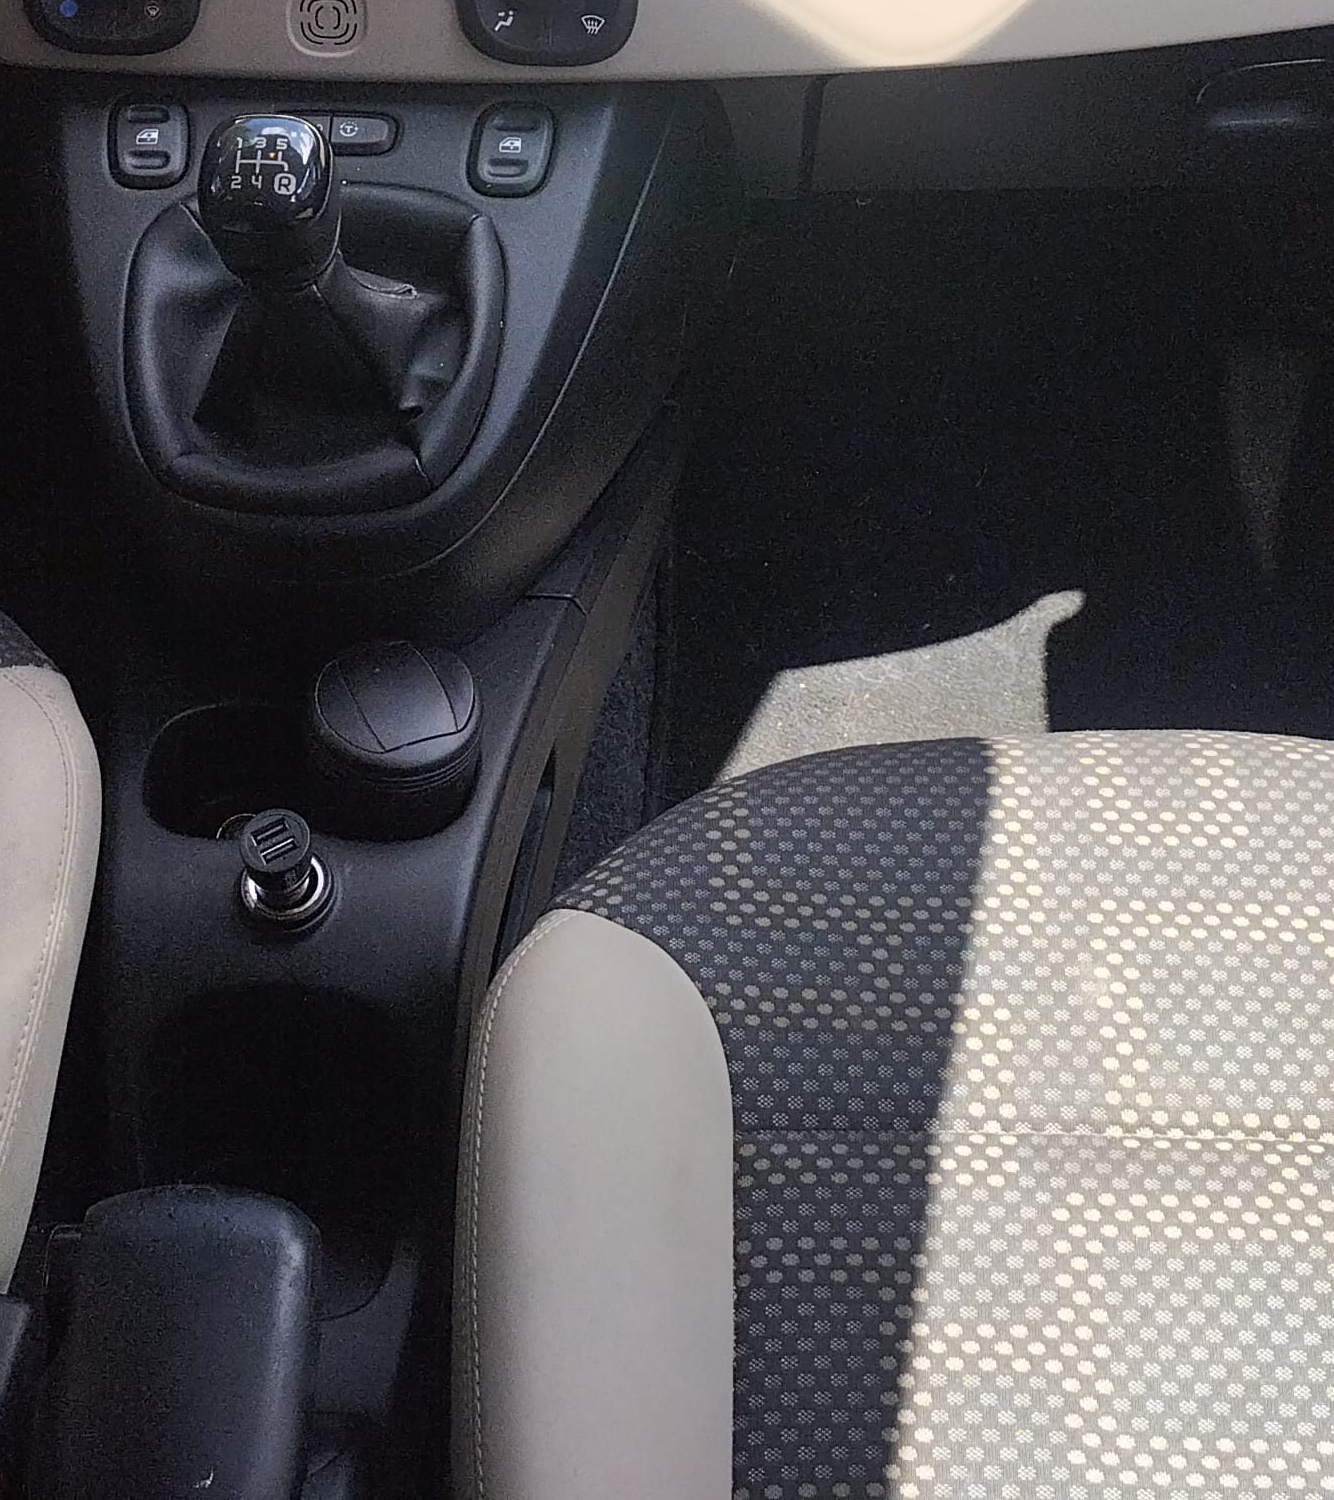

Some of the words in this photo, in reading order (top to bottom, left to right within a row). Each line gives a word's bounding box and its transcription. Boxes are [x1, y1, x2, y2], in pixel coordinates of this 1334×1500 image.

[254, 136, 267, 149] 3
[276, 138, 288, 150] 5
[230, 175, 242, 189] 2
[251, 175, 263, 190] 4
